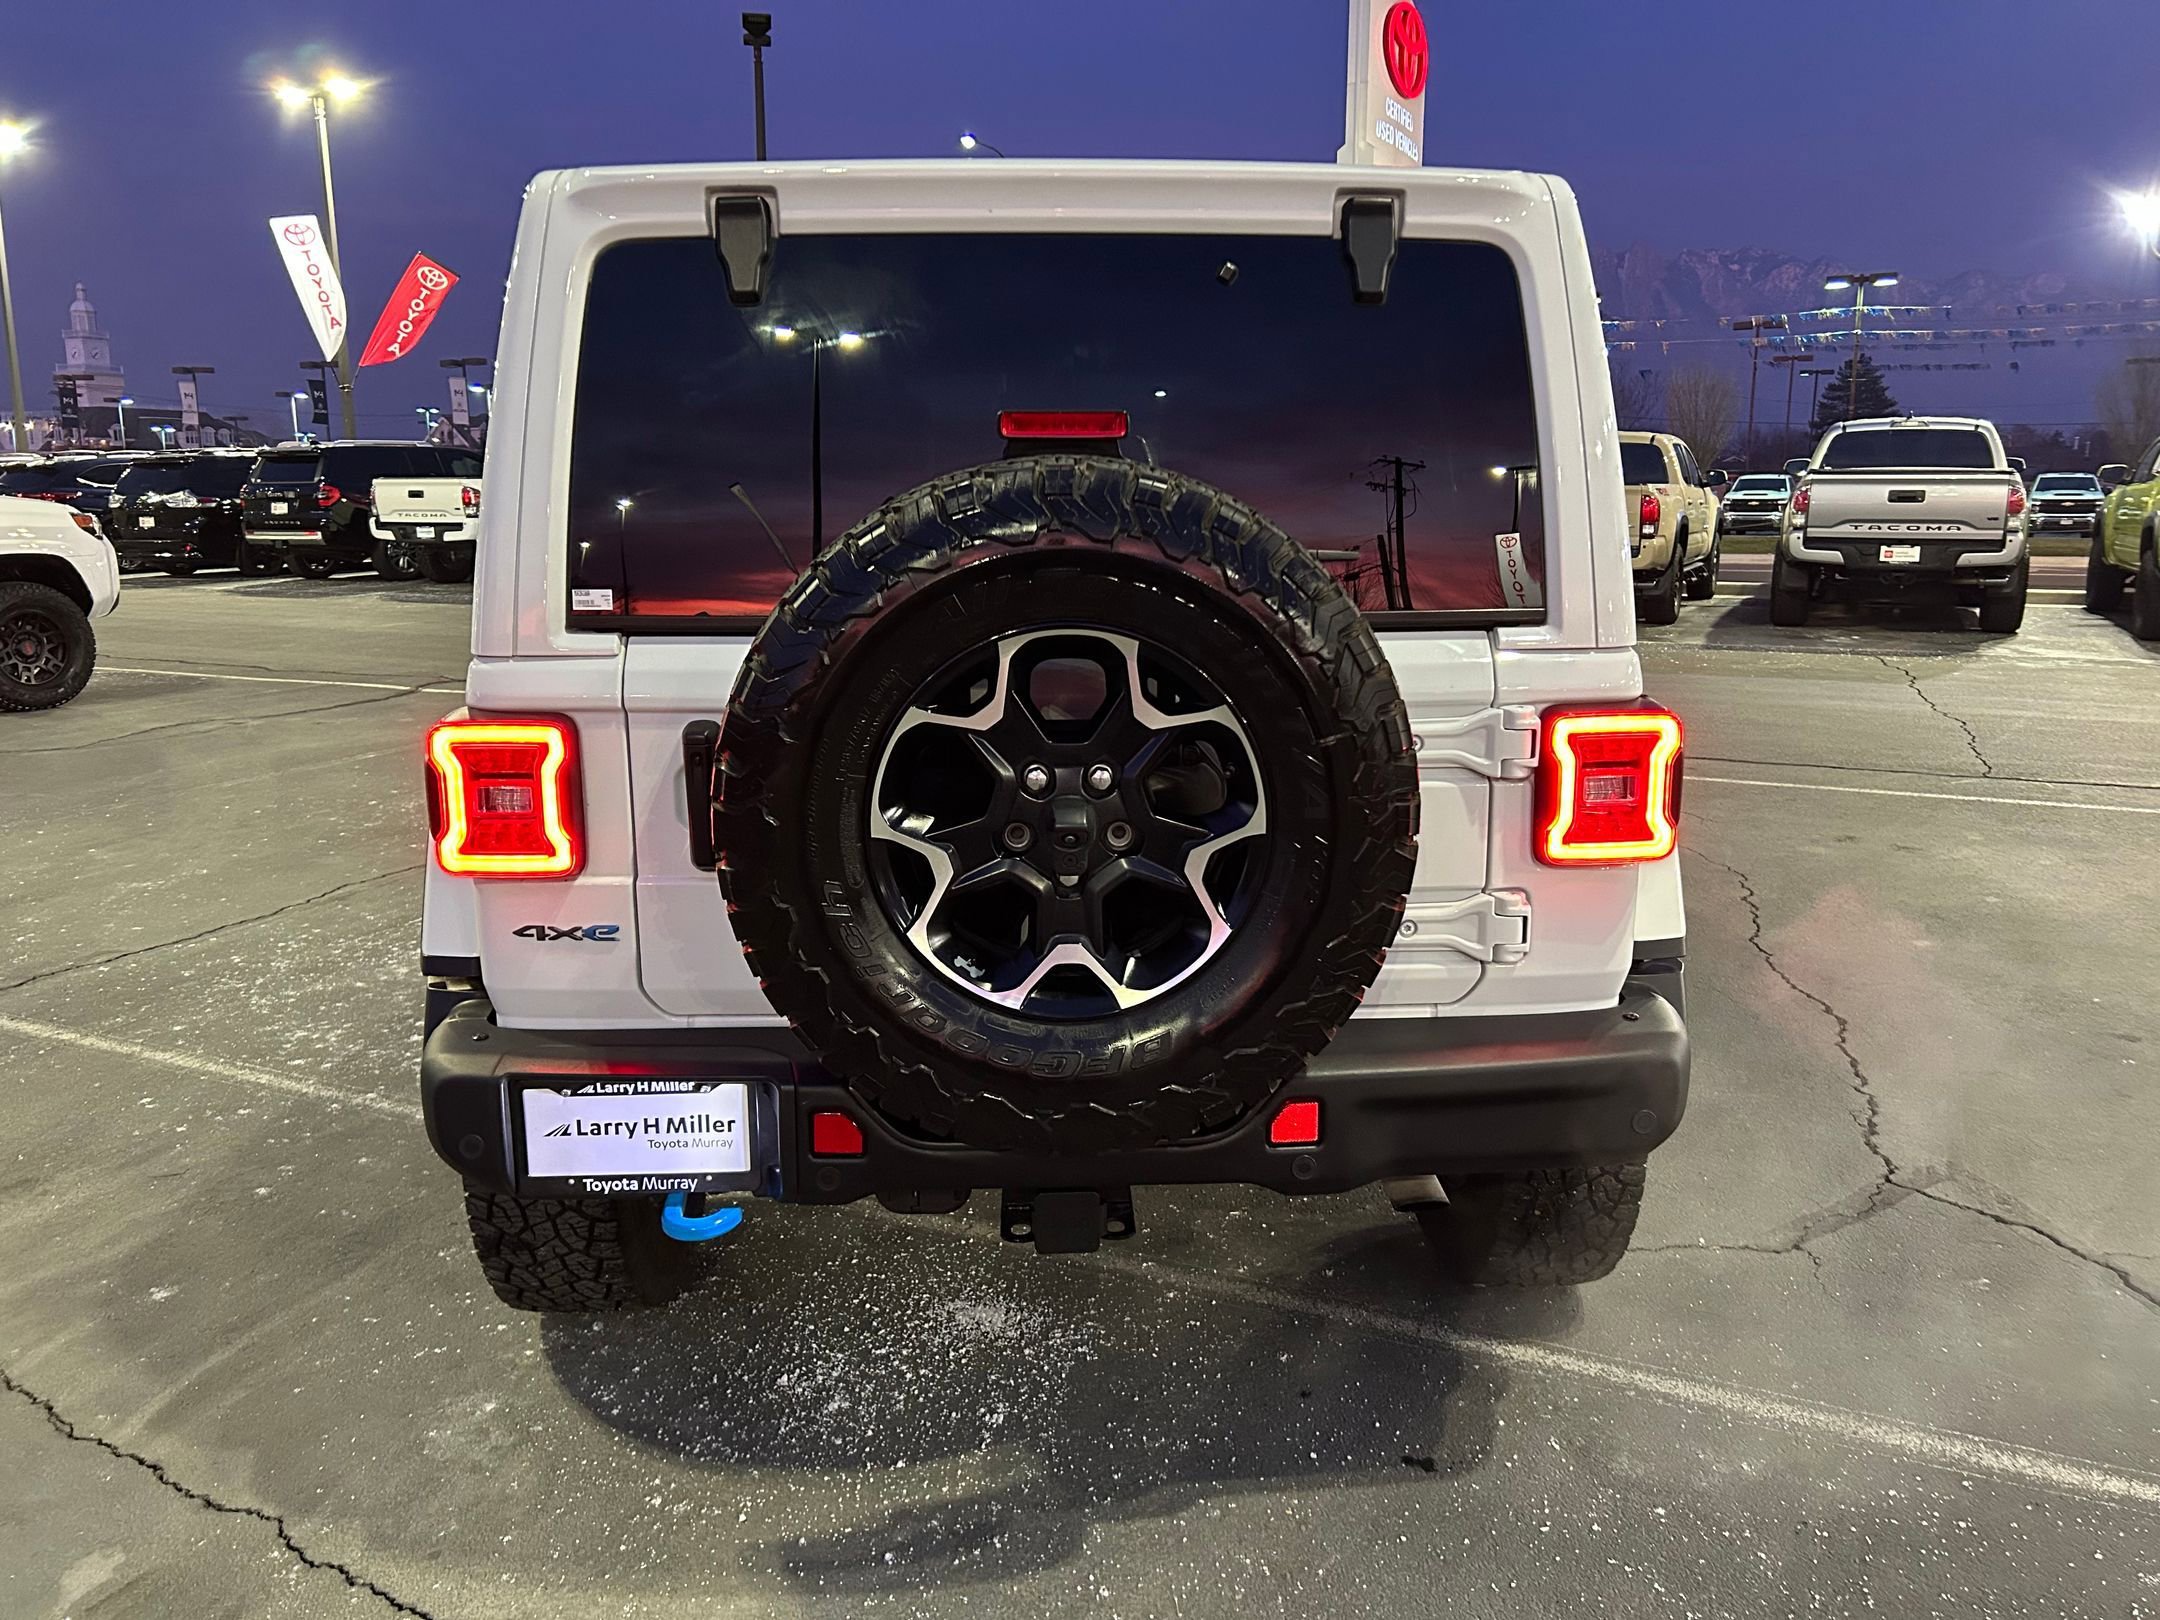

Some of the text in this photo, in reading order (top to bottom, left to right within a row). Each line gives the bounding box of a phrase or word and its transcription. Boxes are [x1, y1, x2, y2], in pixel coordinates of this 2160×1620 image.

[1385, 96, 1414, 133] CERTIFIED
[1376, 119, 1419, 163] USED VEHICLES
[302, 249, 342, 330] TOYOTA
[387, 287, 431, 358] TOYOTA
[1848, 524, 1962, 532] TACOMA
[596, 1080, 696, 1095] Larry H Miller
[576, 1114, 736, 1140] Larry H Miller
[647, 1138, 734, 1151] Toyota Murray
[582, 1176, 698, 1195] Toyota Murray
